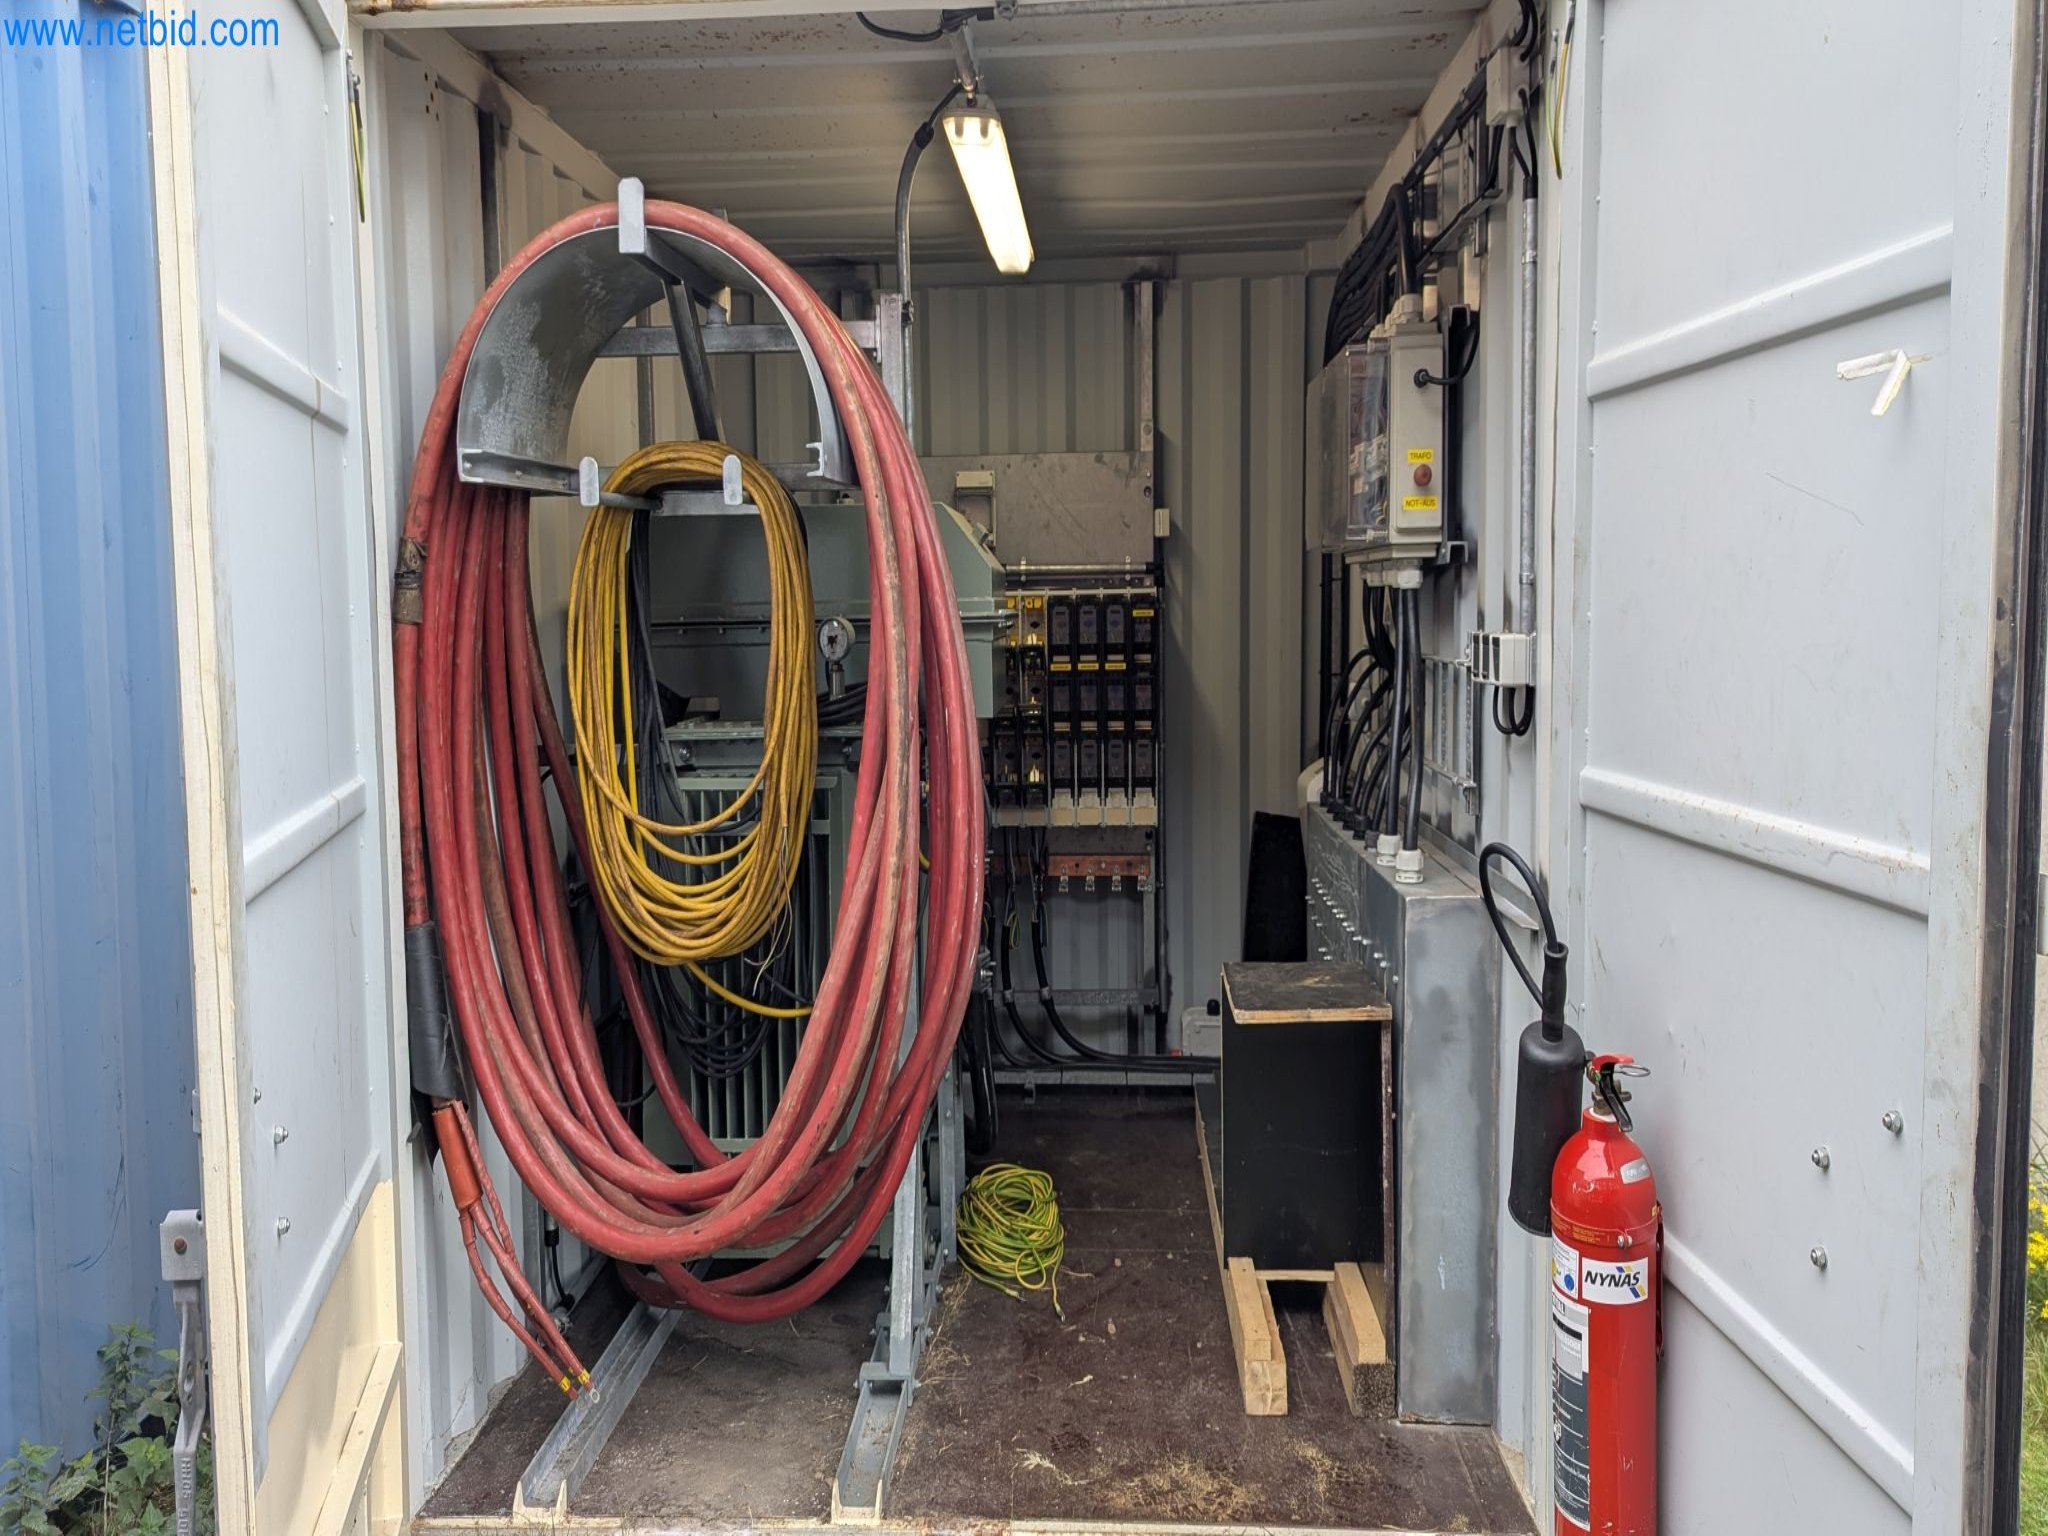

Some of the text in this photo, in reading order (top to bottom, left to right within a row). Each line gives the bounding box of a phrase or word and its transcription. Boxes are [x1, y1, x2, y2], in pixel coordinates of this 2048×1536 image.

[1409, 451, 1432, 460] TRAFO
[1405, 499, 1436, 507] NOT-AUS
[1584, 1270, 1641, 1288] NYNAS
